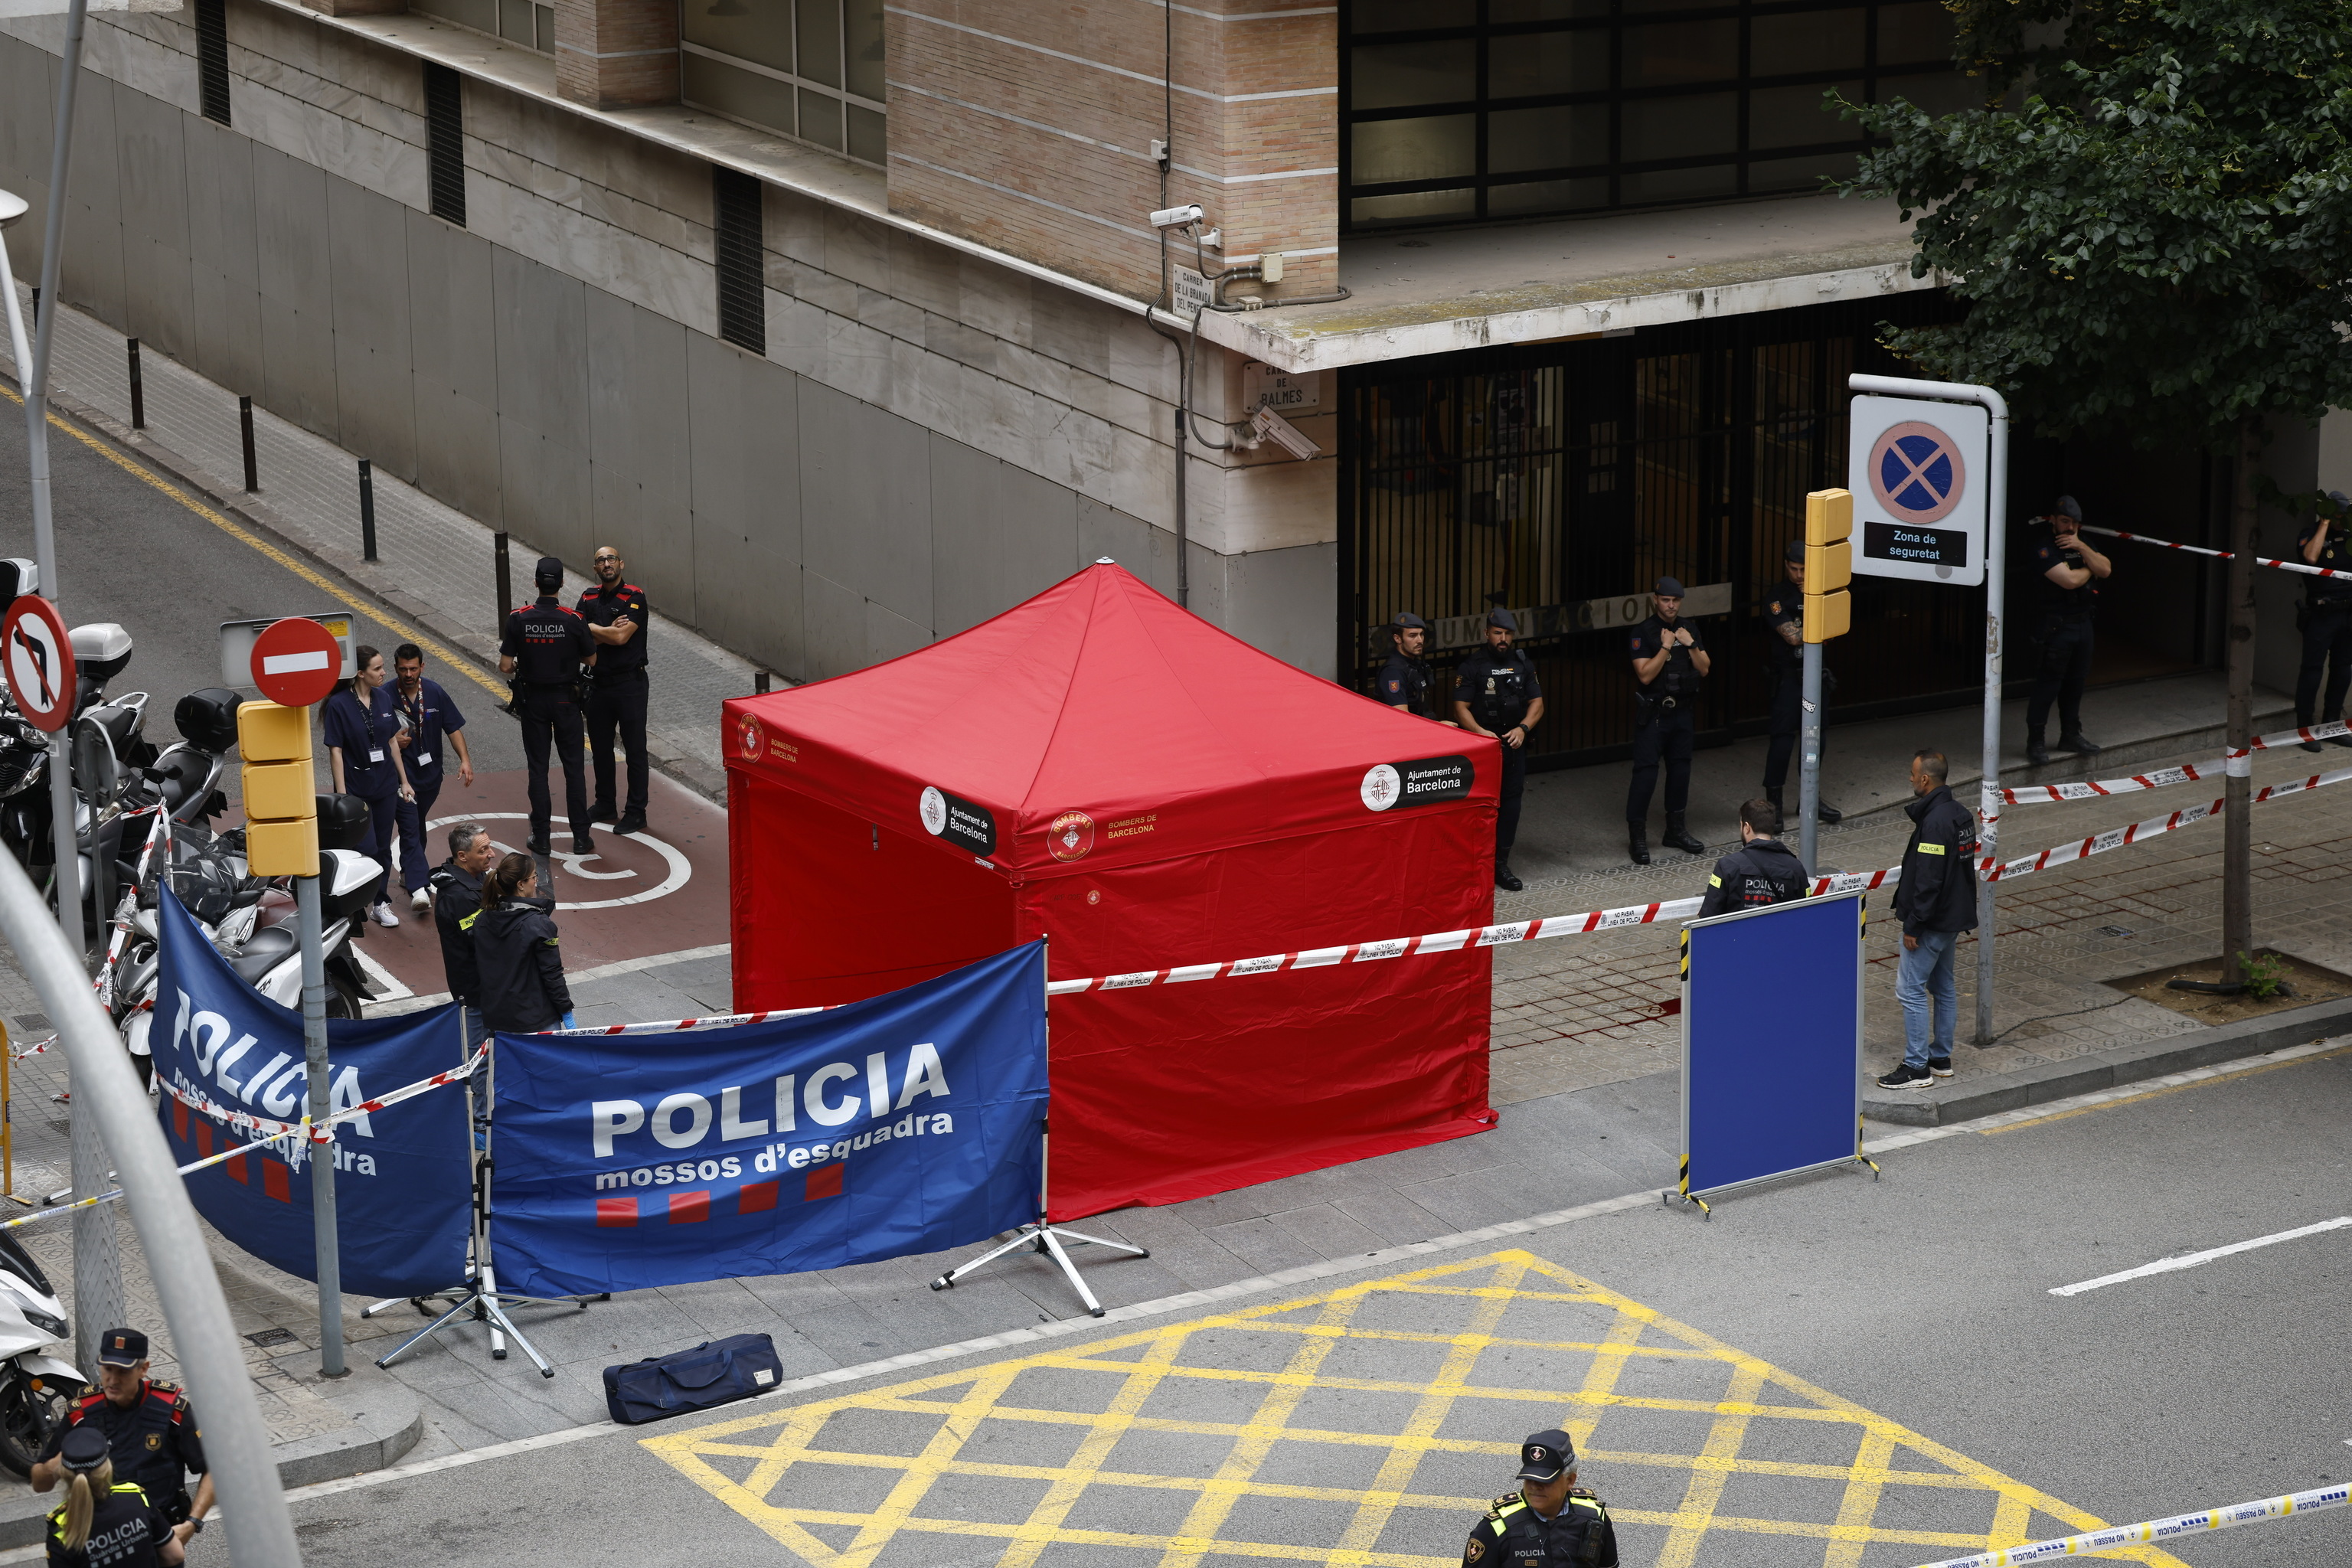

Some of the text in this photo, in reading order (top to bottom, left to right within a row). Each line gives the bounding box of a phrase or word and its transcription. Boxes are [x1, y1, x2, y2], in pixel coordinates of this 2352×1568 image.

[1183, 273, 1203, 287] CARRER
[1174, 282, 1210, 303] DE LA GRANADA
[1177, 297, 1186, 309] DEL
[1266, 366, 1289, 376] CAR
[1276, 377, 1287, 388] DE
[1261, 389, 1302, 406] BALMES
[1893, 530, 1936, 544] Zona de
[1890, 547, 1940, 560] seguretat
[525, 625, 565, 633] POLICIA
[1370, 596, 1657, 654] DCUMNTACION
[741, 716, 763, 735] BOMBERS
[771, 738, 799, 755] BOMBERS DE
[770, 747, 797, 763] BARCELONA
[1407, 766, 1462, 782] Ajuntament de
[1406, 779, 1461, 794] Barcelona
[951, 806, 988, 829] Ajuntament de
[1054, 814, 1092, 833] BOMBERS
[1108, 814, 1157, 829] BOMBERS DE
[950, 817, 988, 844] Barcelona
[1108, 824, 1155, 839] BARCELONA
[1983, 832, 1994, 841] LINEA
[1057, 847, 1086, 860] BARCELONA
[591, 1042, 951, 1158] POLICIA
[230, 1109, 377, 1176] d'esqdra
[596, 1156, 742, 1191] mossos
[2297, 1500, 2320, 1511] POLICIA
[2236, 1508, 2266, 1521] NO PASSEU
[85, 1517, 147, 1554] POLICIA
[2156, 1524, 2181, 1537] POLICIA
[89, 1530, 149, 1562] Guàrdia Urbana
[2093, 1534, 2125, 1547] NO PASSEU
[1514, 1549, 1546, 1557] POLICIA
[2012, 1550, 2037, 1562] POLICIA
[1971, 1560, 1980, 1568] NO
